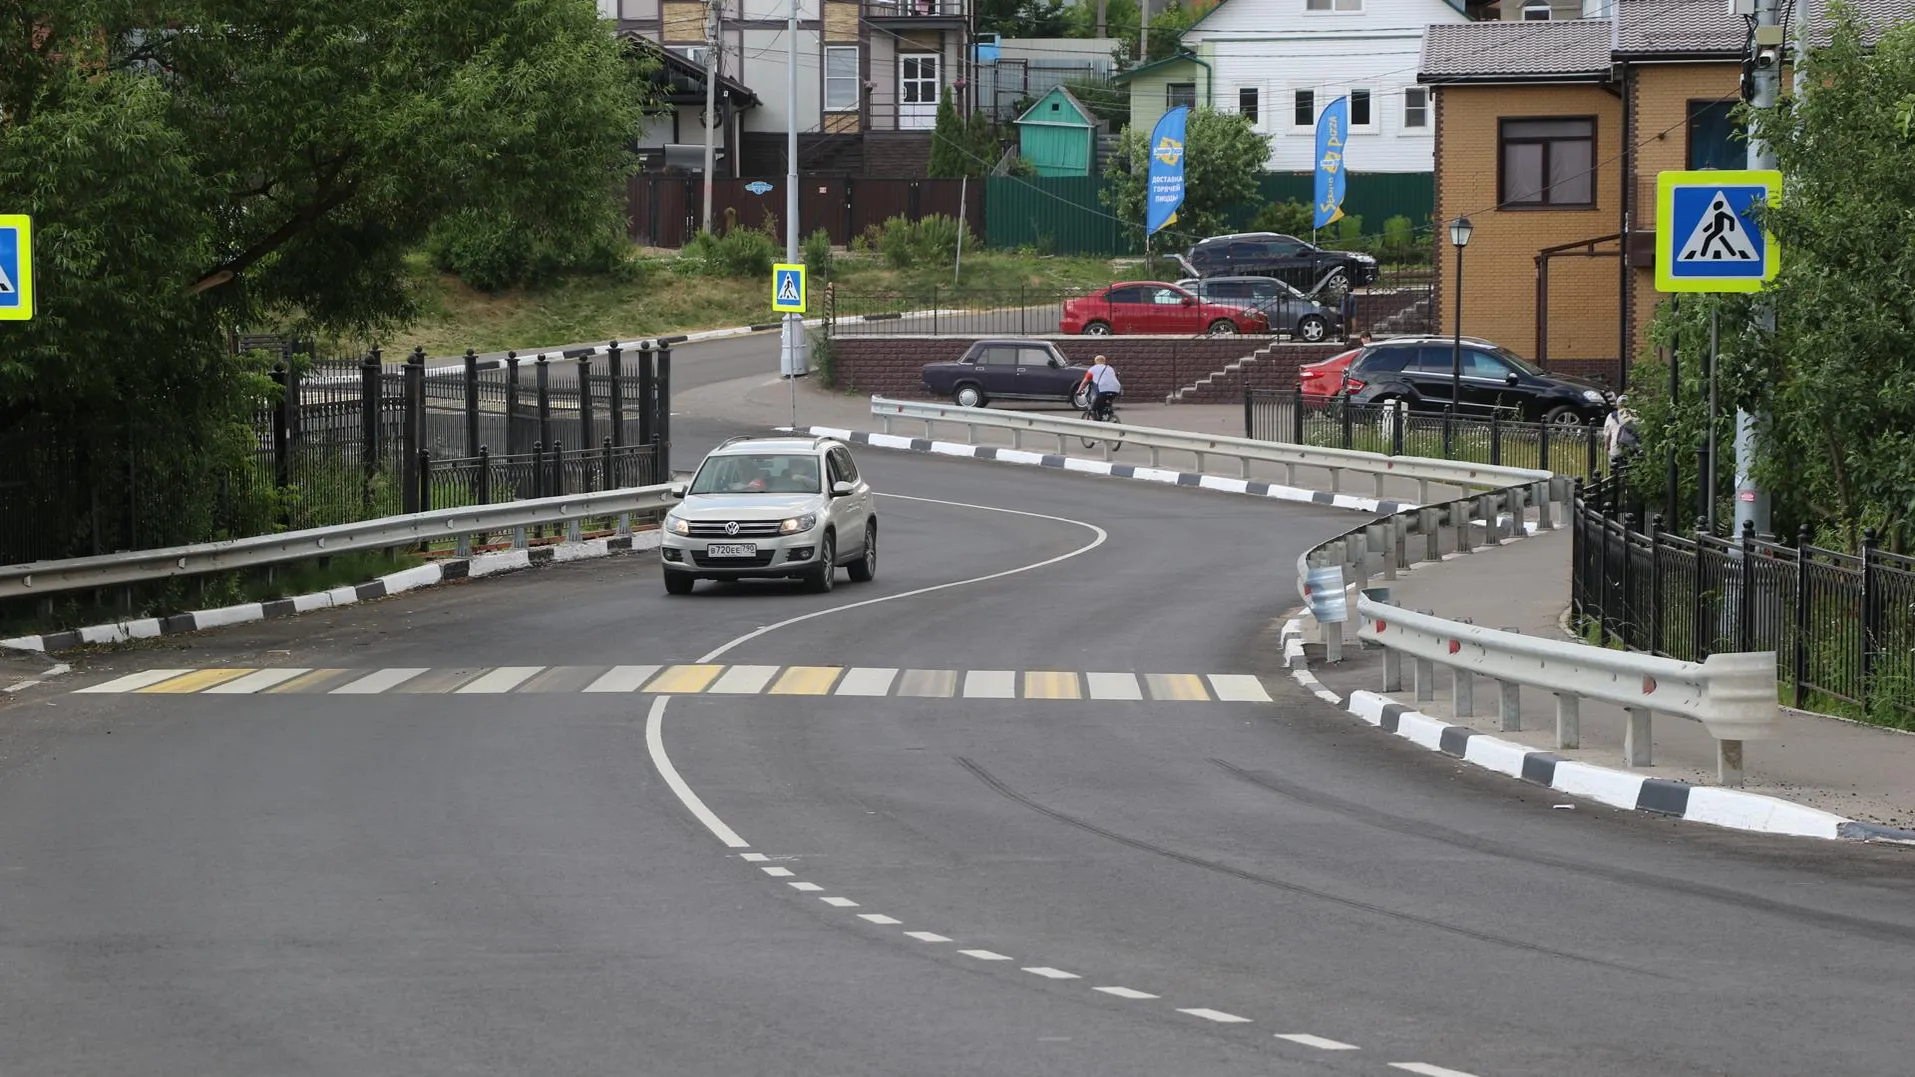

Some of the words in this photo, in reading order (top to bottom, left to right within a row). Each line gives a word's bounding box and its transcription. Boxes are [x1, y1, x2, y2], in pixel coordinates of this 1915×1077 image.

[1152, 176, 1183, 184] ДОСТАВКА
[1153, 184, 1181, 193] ГОРЯЧЕЙ
[1155, 195, 1179, 203] ПИЦЦЫ
